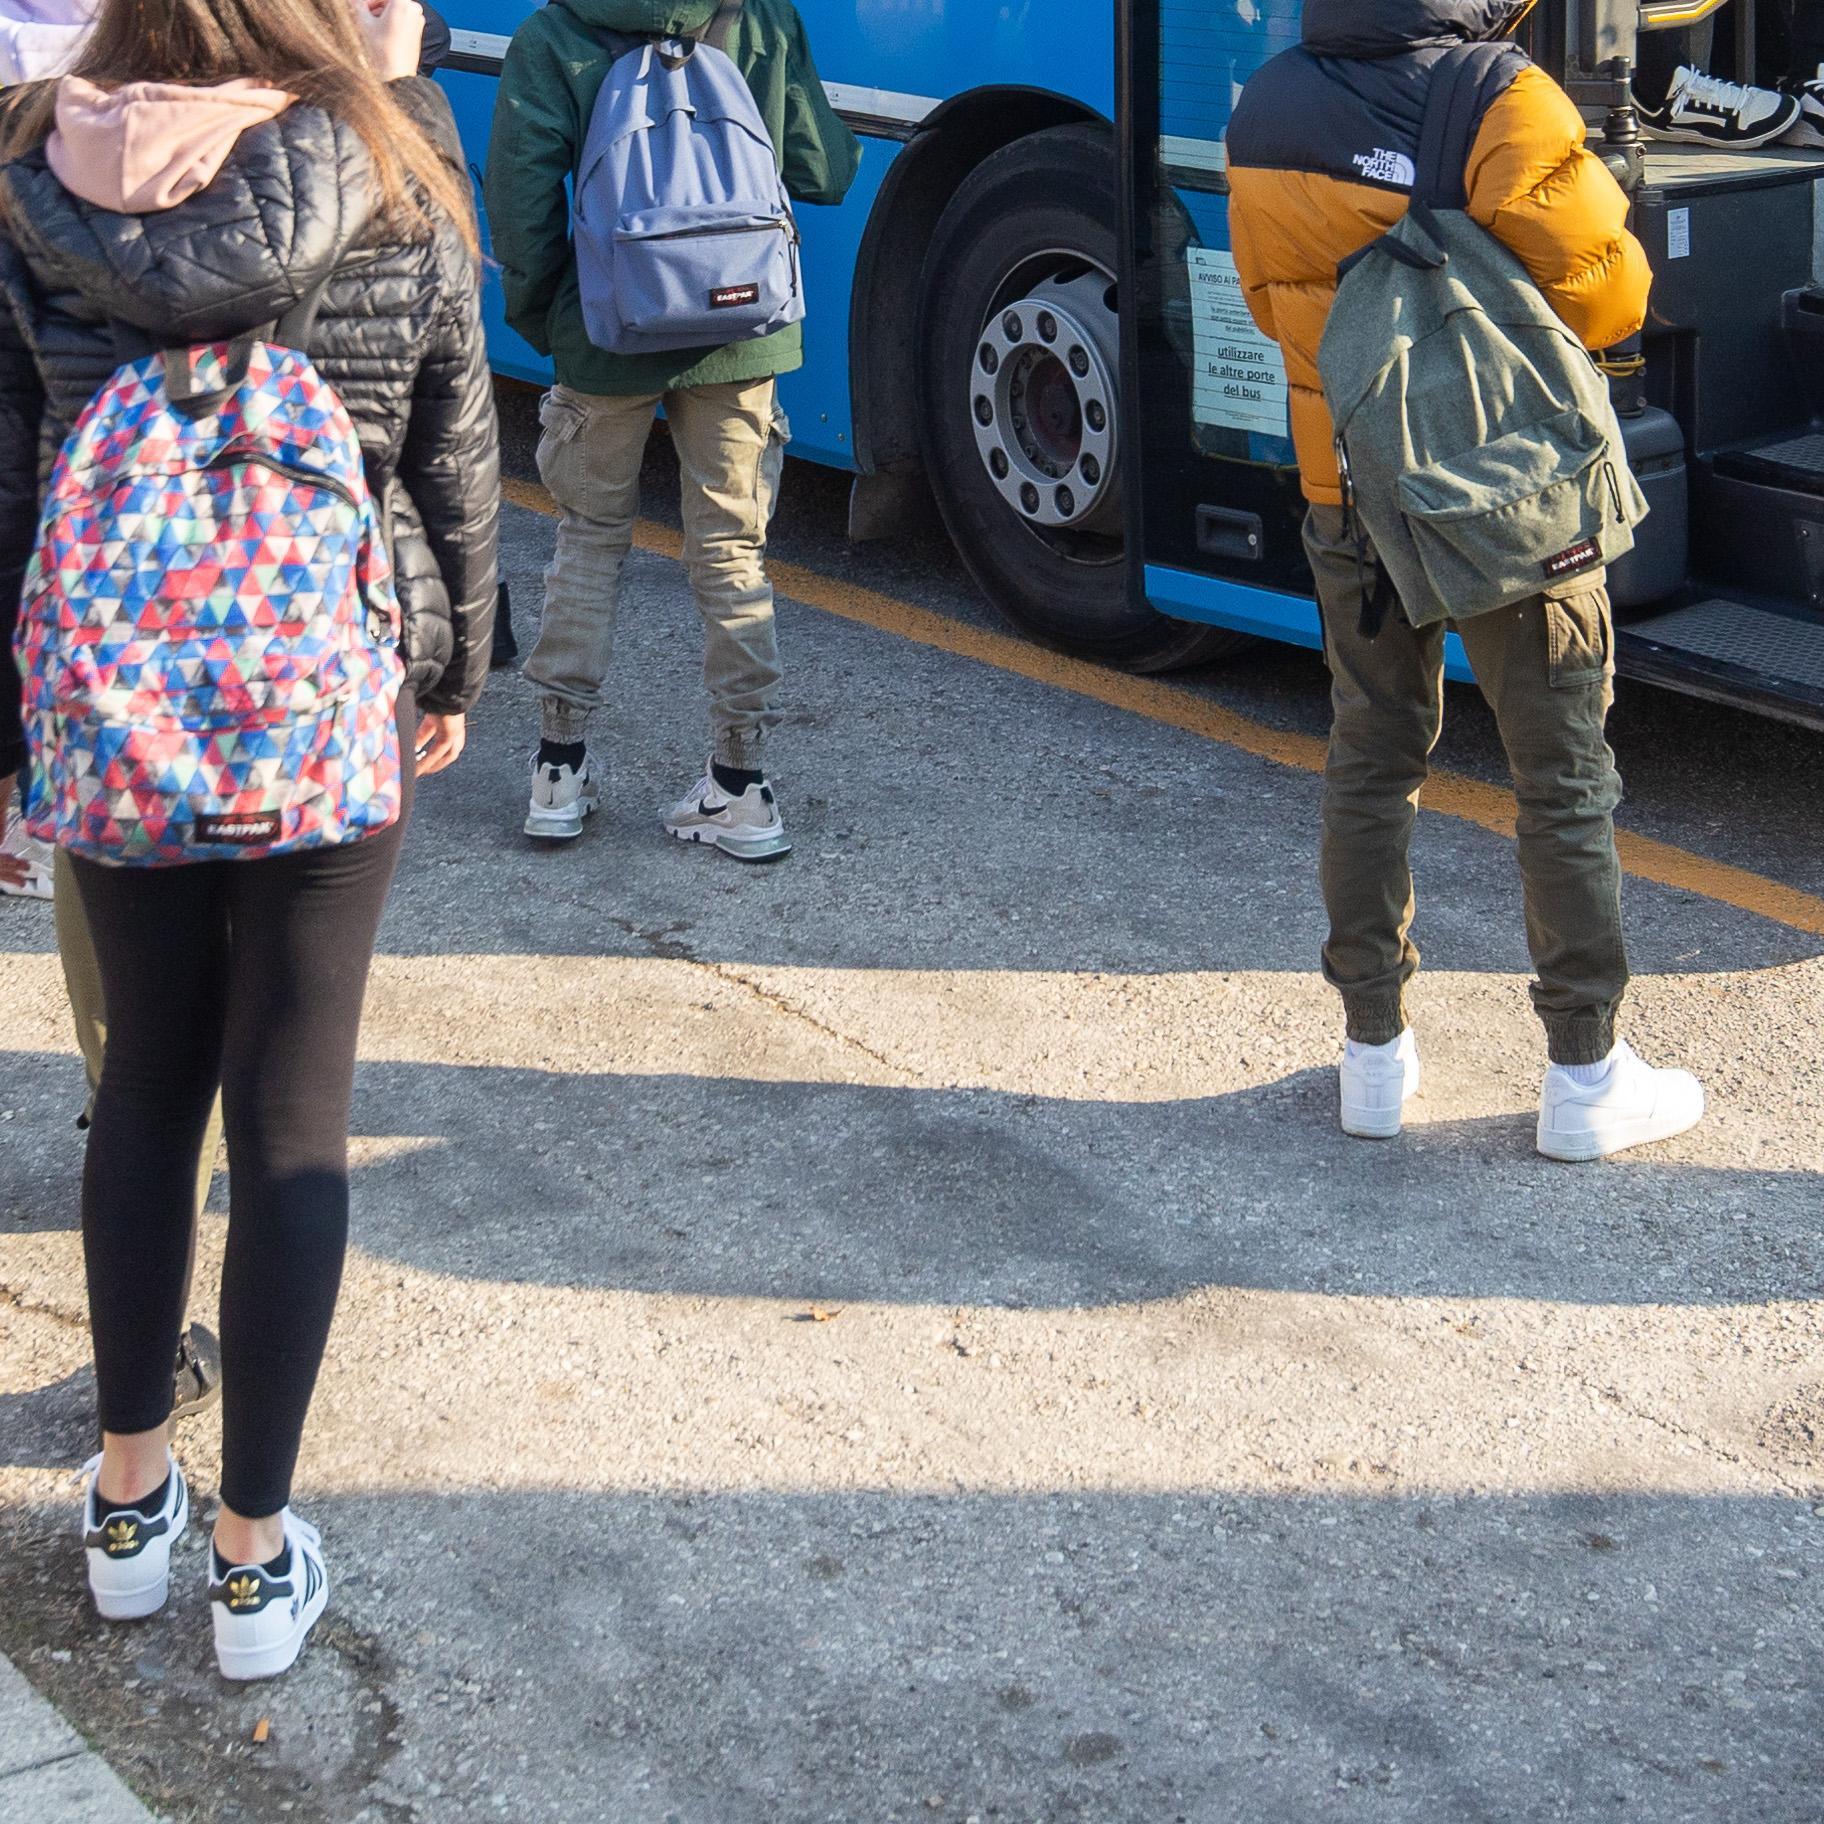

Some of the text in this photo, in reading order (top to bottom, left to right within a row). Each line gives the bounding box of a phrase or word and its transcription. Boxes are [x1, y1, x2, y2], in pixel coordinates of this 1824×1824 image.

[1373, 147, 1397, 163] THE
[1353, 154, 1396, 173] NORTH
[1361, 166, 1394, 181] FACE
[1217, 346, 1265, 362] utilizzare
[1208, 362, 1276, 385] le altre porte
[1223, 383, 1261, 400] del bus
